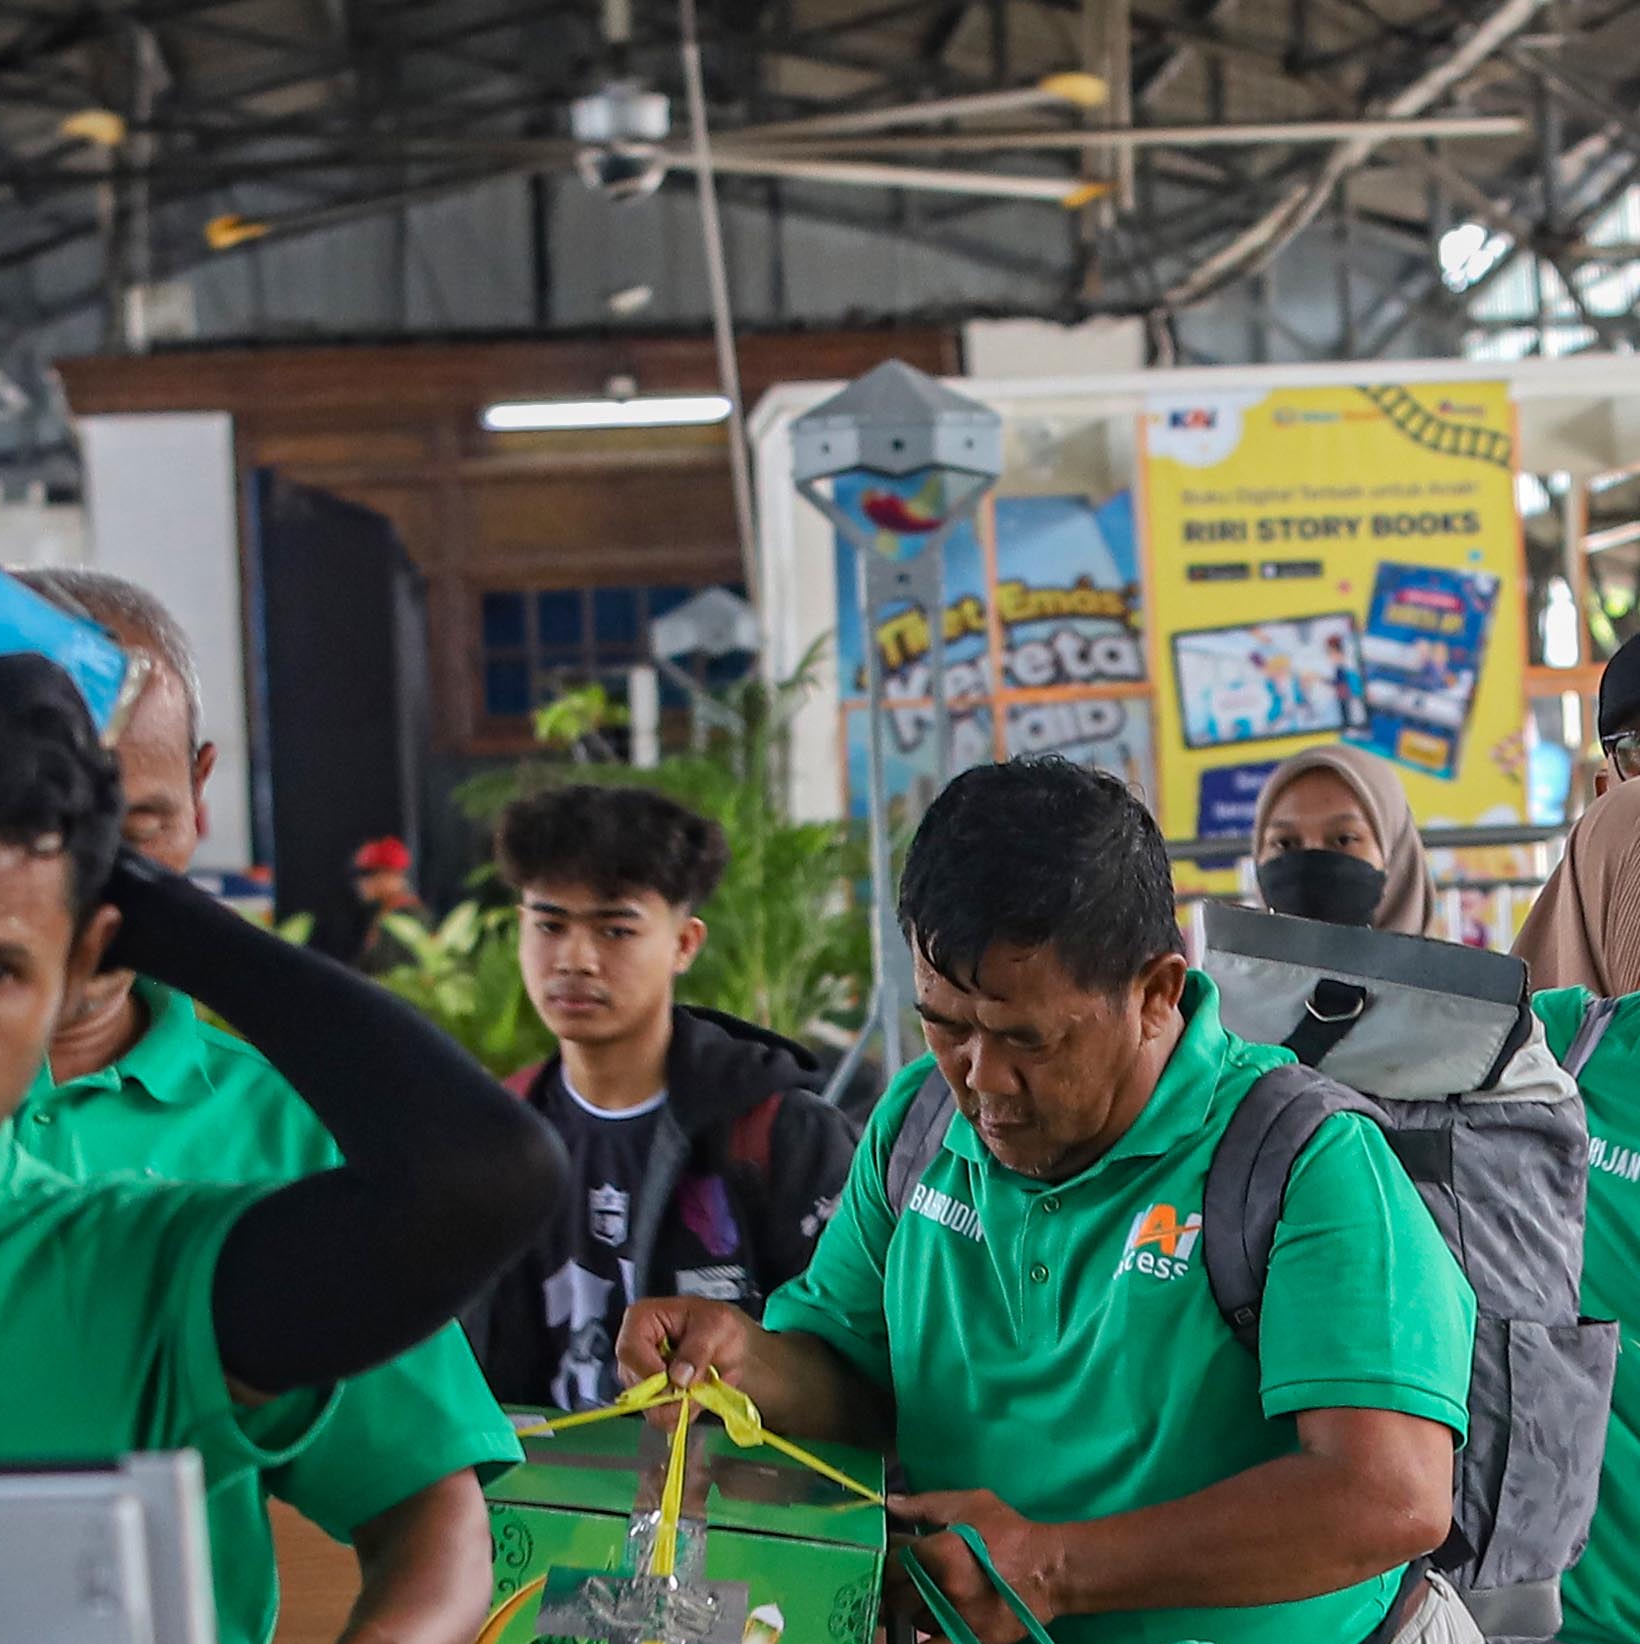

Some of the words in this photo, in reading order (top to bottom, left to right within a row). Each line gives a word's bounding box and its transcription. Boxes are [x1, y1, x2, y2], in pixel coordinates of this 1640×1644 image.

[1182, 518, 1248, 544] RIRI
[1256, 513, 1362, 541] STORY
[1370, 507, 1480, 538] BOOKS
